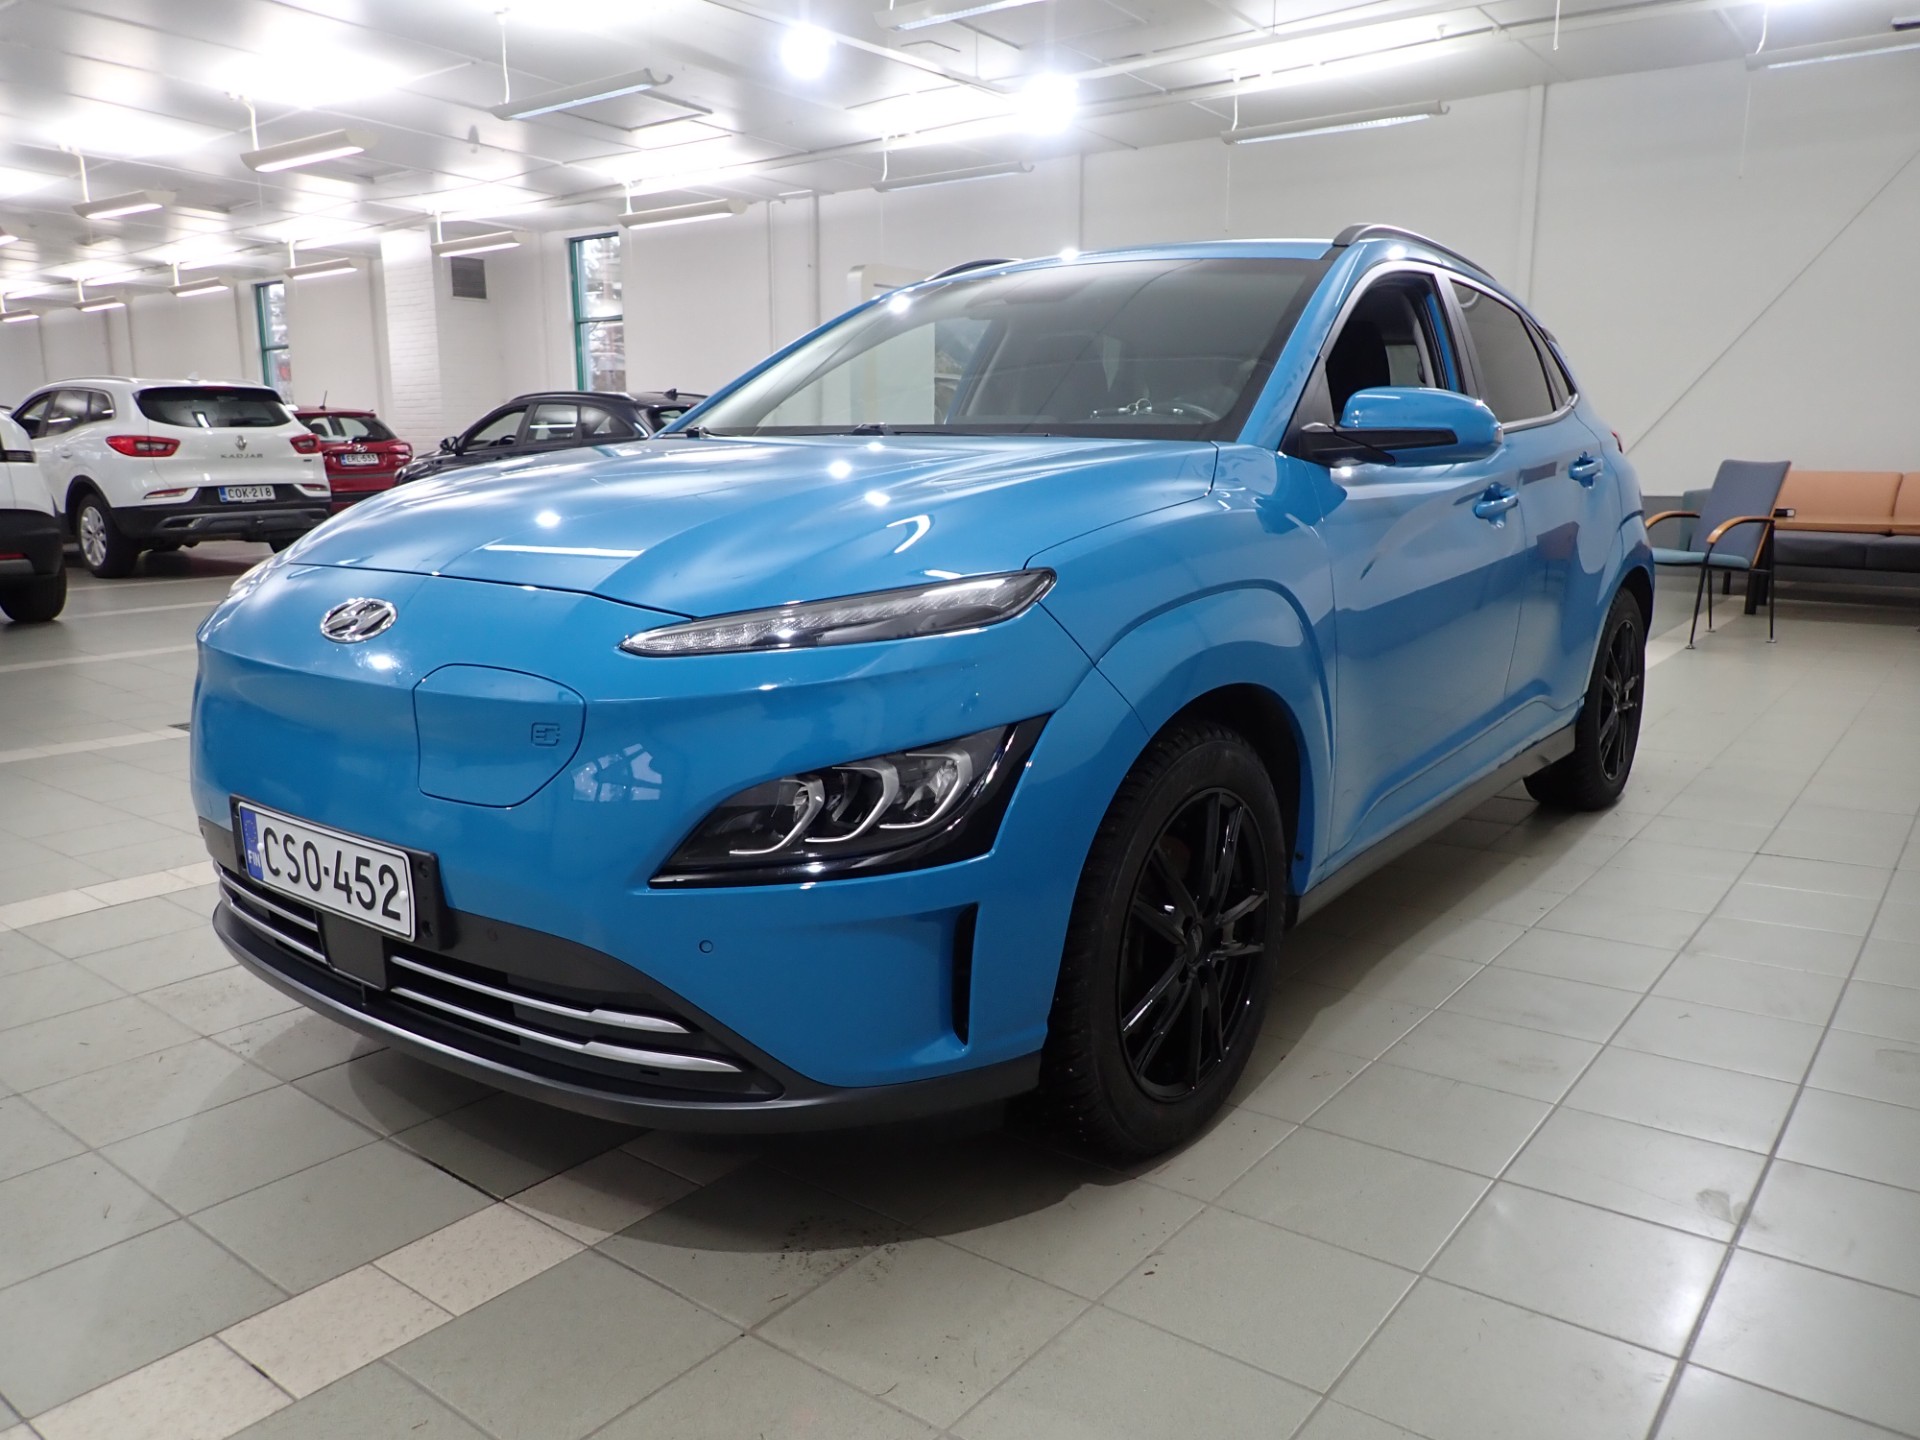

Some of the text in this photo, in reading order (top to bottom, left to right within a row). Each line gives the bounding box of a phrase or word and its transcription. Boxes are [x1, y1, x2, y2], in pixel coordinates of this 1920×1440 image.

[227, 487, 272, 498] COK-218
[247, 849, 261, 868] FIN
[263, 826, 401, 921] CSO-452
